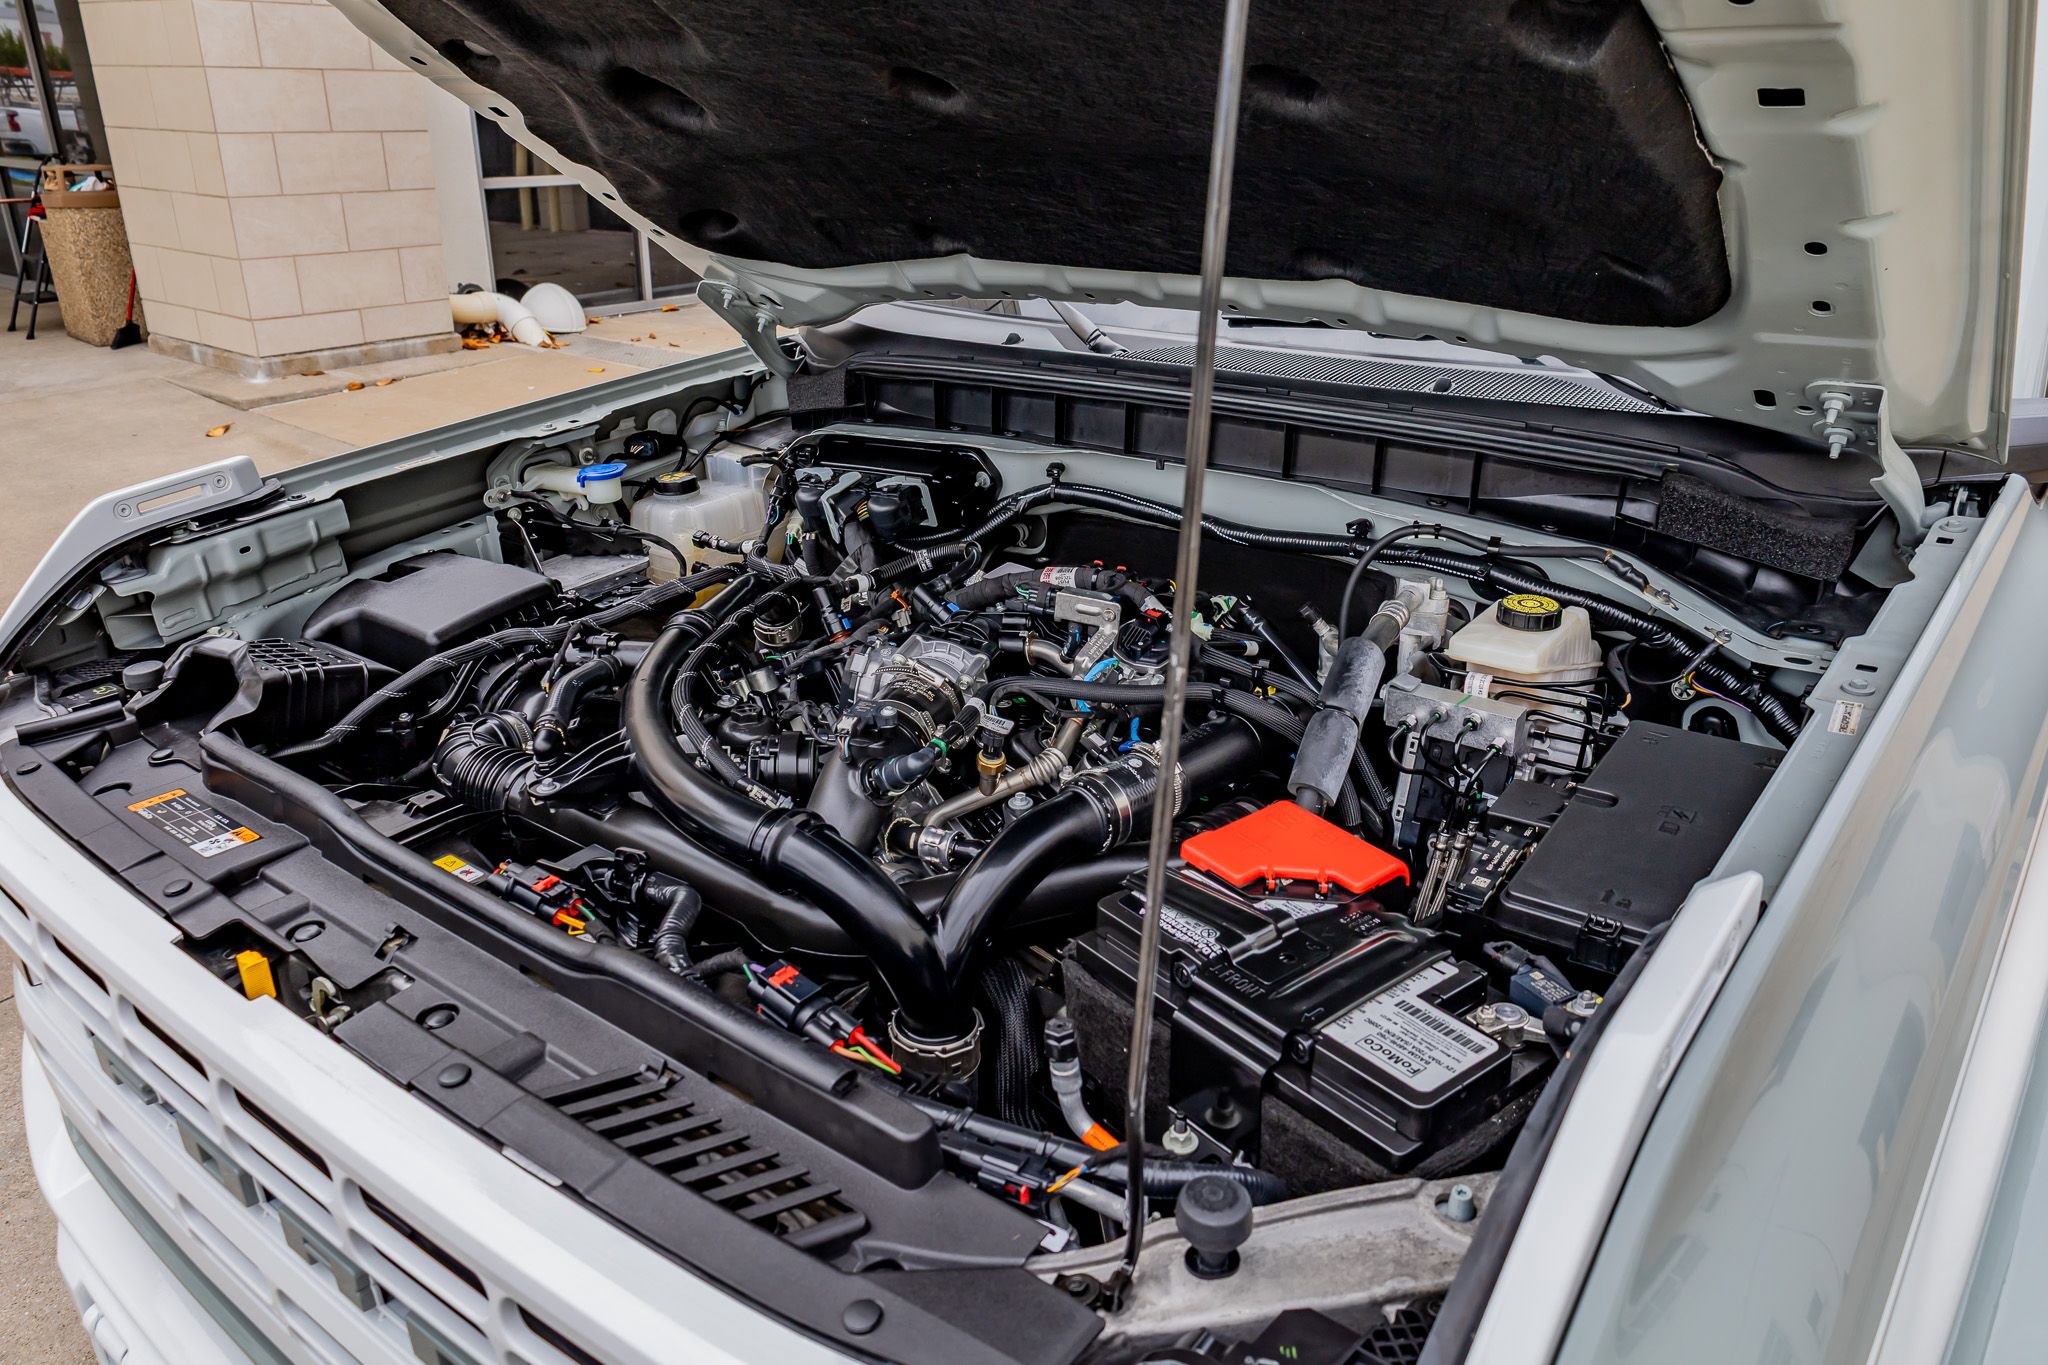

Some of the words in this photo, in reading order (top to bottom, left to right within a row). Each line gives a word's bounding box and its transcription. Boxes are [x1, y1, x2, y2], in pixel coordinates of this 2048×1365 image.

[1159, 920, 1212, 955] DANGER/POIS
[1364, 1038, 1420, 1075] FoMoCo
[1445, 1065, 1456, 1073] 12V
